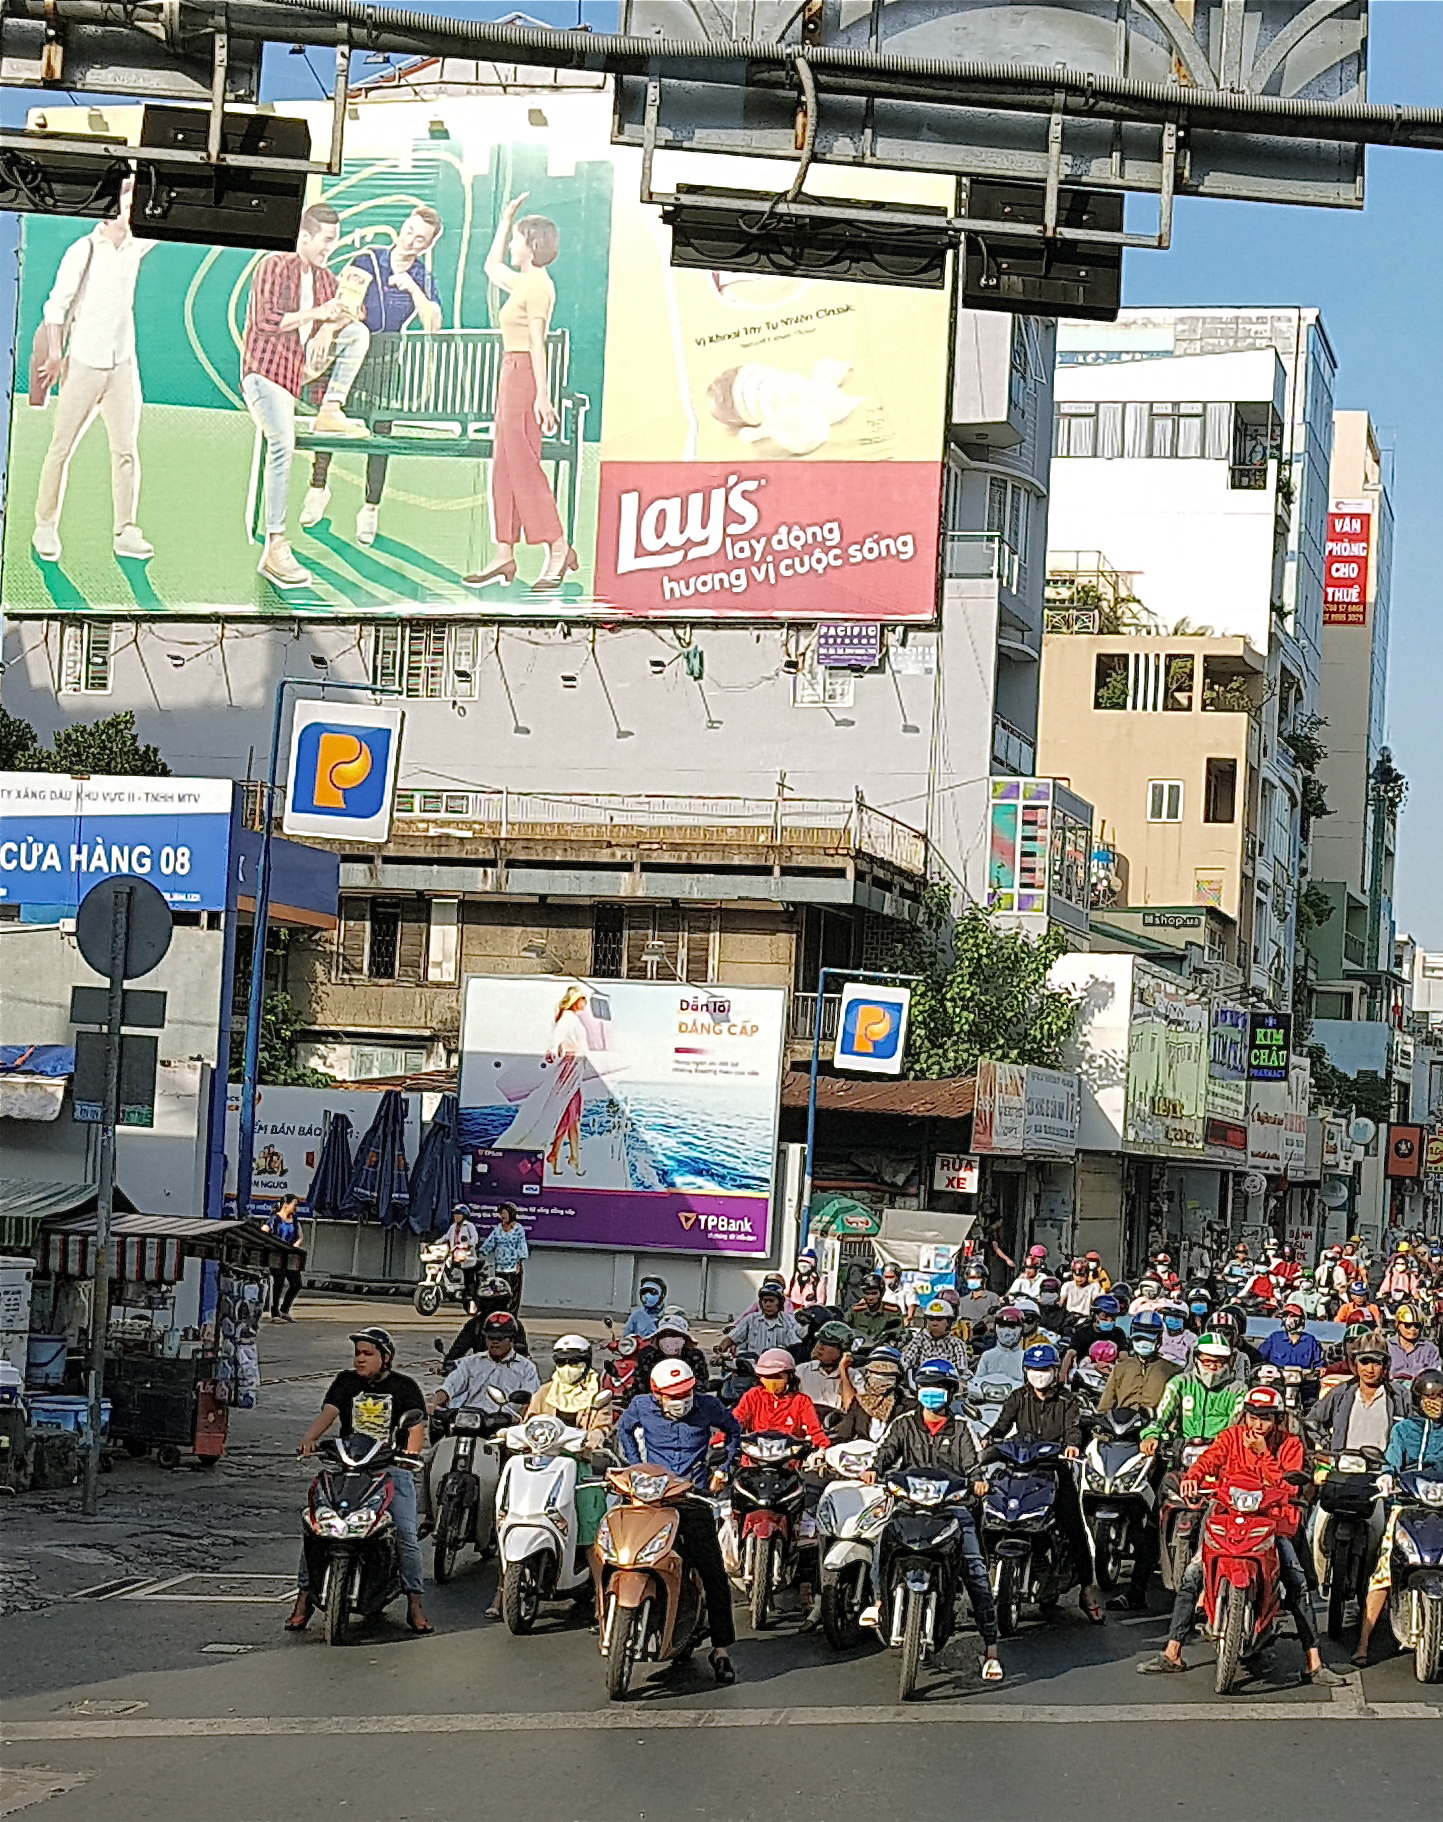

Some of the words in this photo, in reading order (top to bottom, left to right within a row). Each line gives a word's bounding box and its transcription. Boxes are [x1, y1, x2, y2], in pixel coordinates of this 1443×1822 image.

[617, 474, 760, 574] Lay's
[726, 536, 767, 560] lay
[771, 520, 840, 551] động
[1325, 539, 1368, 556] PHÒNG
[663, 567, 747, 600] hương
[751, 555, 776, 584] vị
[780, 548, 843, 574] cuộc
[848, 533, 914, 563] sống
[1331, 562, 1359, 578] CHO
[820, 626, 877, 636] PACIFIC
[178, 792, 201, 804] MTV
[1, 836, 61, 872] CỬA
[70, 836, 151, 874] HÀNG
[160, 845, 191, 876] 08
[1255, 1028, 1284, 1045] KIM
[1250, 1047, 1287, 1067] CHÂU
[945, 1176, 967, 1189] XE
[698, 1215, 753, 1233] TPBank
